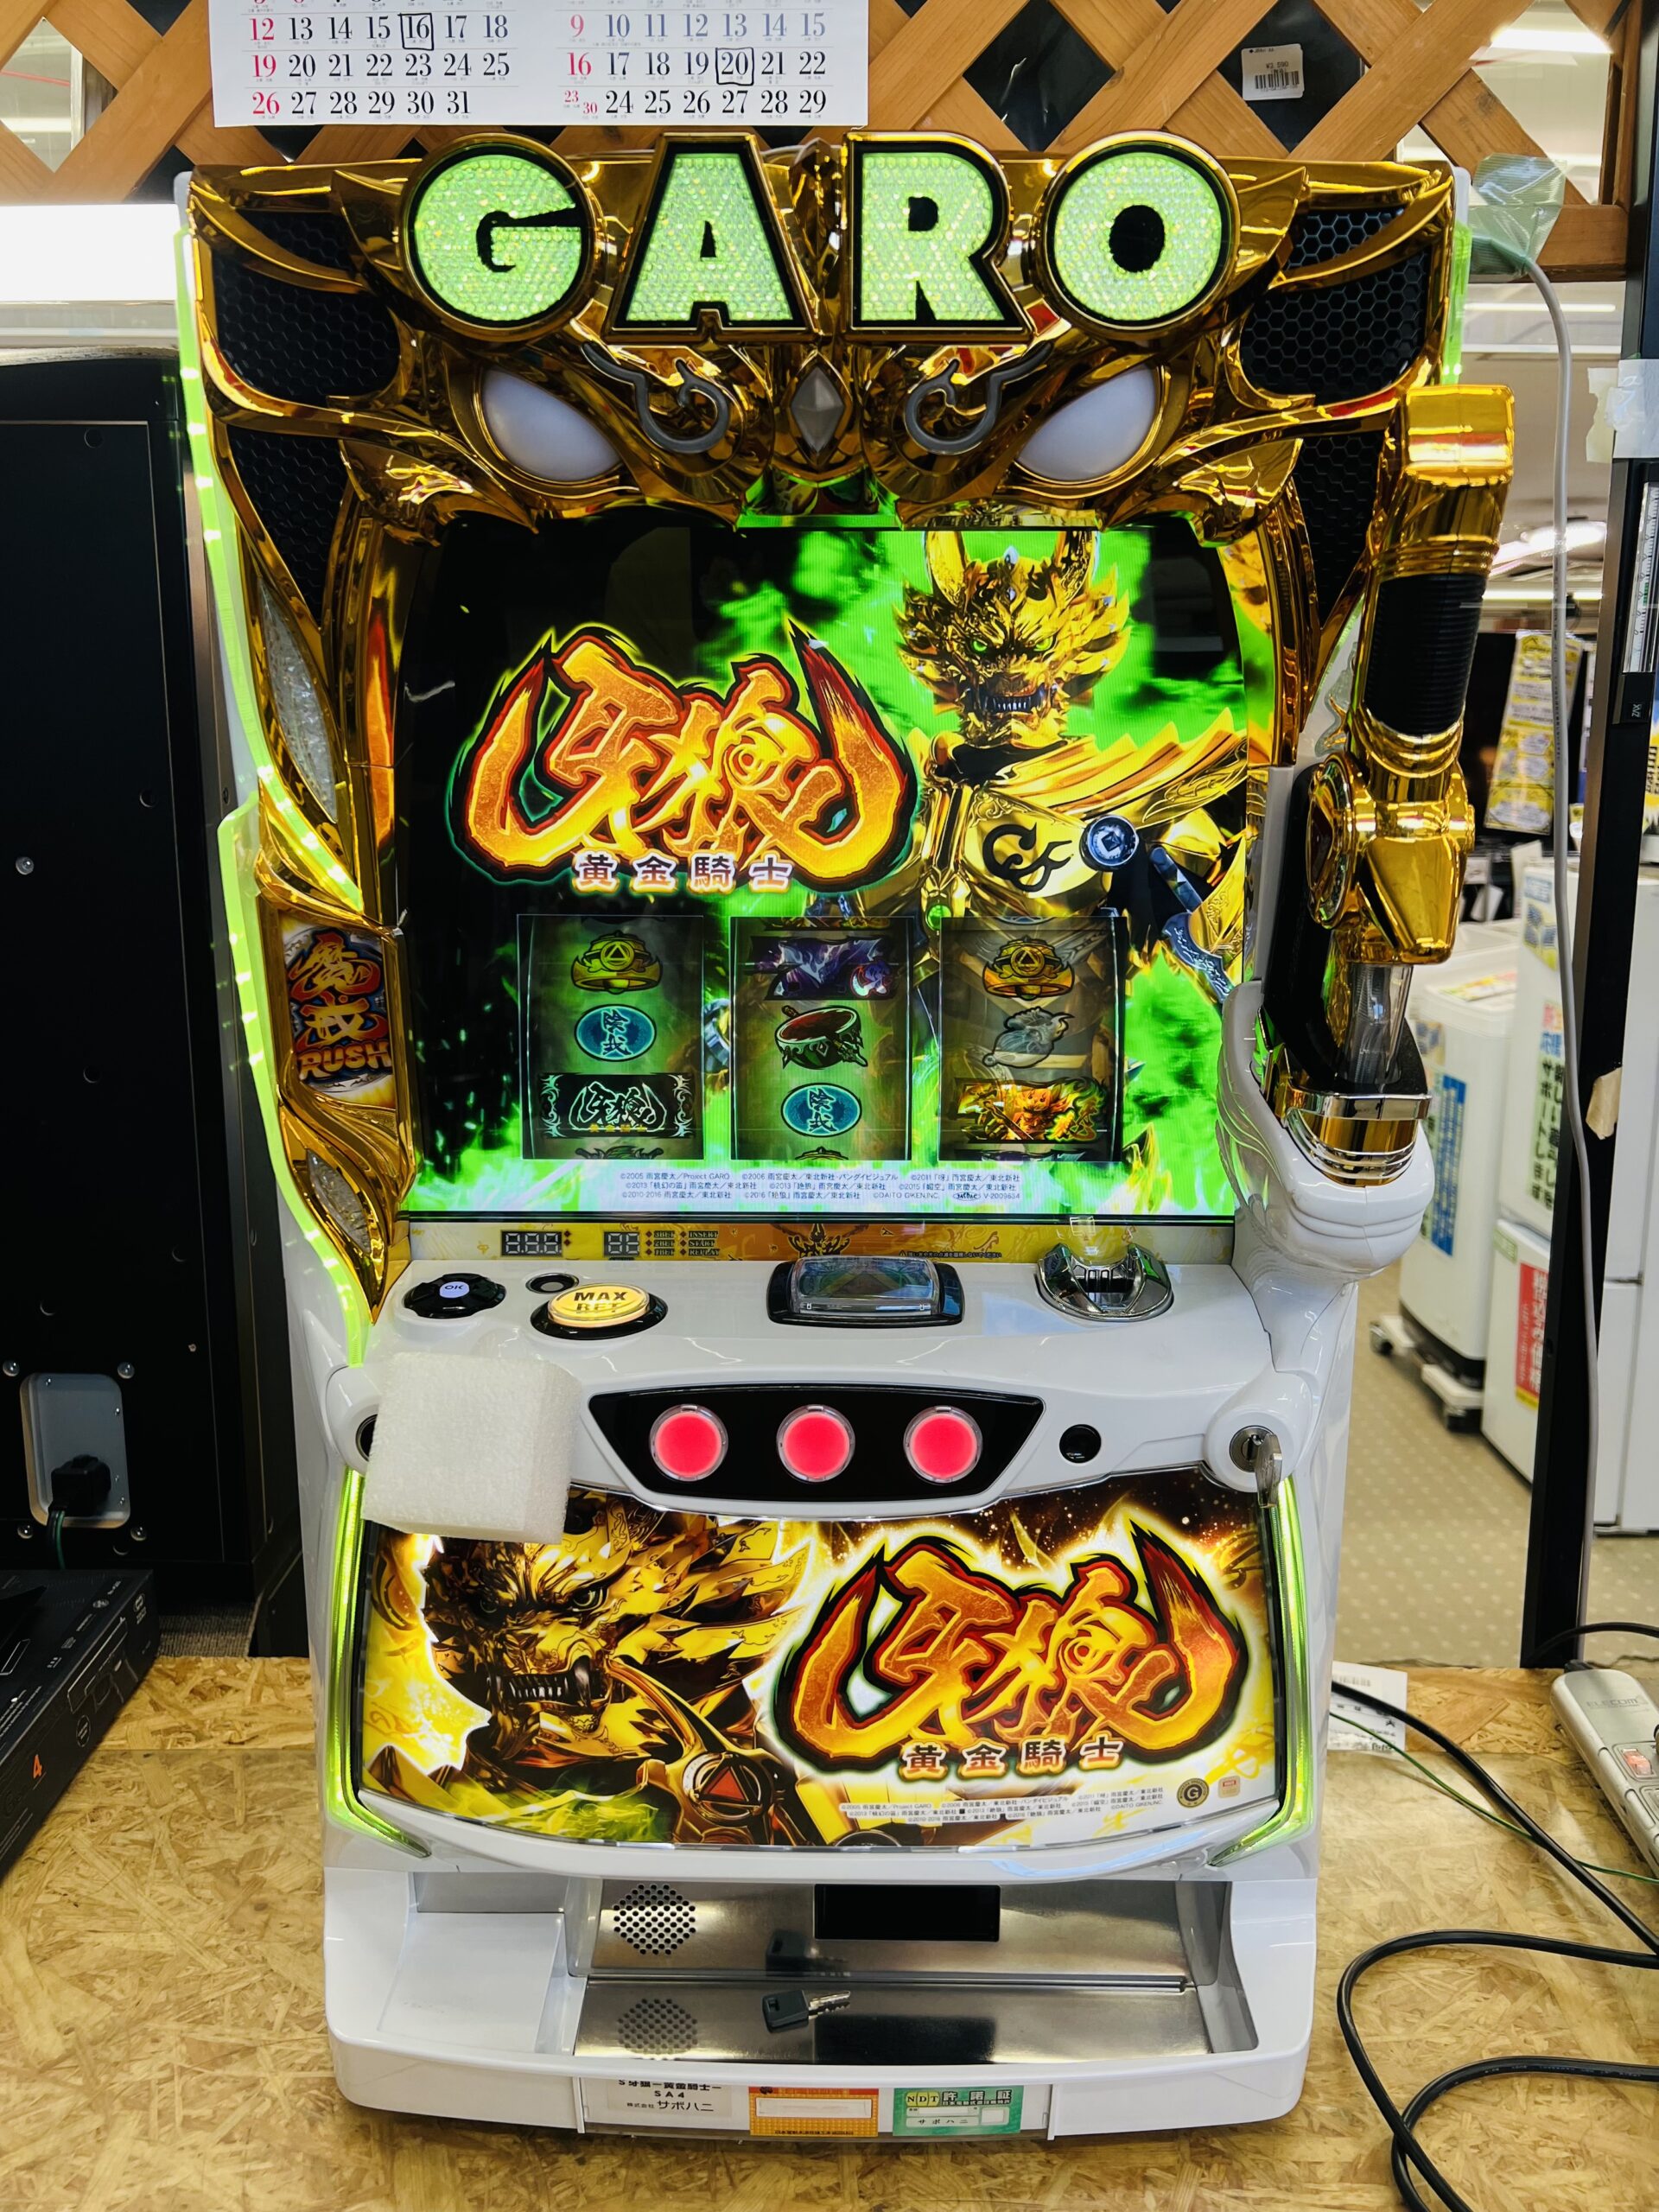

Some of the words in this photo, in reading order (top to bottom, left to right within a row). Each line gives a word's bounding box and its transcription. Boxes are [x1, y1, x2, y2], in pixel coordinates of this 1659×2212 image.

[250, 18, 275, 41] 12
[289, 16, 313, 40] 13
[327, 16, 353, 40] 14
[365, 16, 391, 39] 15
[405, 16, 430, 39] 16
[443, 16, 467, 38] 17
[482, 15, 508, 38] 18
[570, 14, 584, 37] 9
[605, 14, 630, 37] 10
[645, 14, 669, 36] 11
[683, 14, 708, 37] 12
[722, 14, 747, 36] 13
[761, 13, 787, 36] 14
[800, 12, 825, 36] 15
[251, 54, 276, 77] 19
[289, 54, 315, 77] 20
[328, 54, 353, 77] 21
[365, 54, 392, 76] 22
[405, 54, 431, 76] 23
[443, 53, 472, 76] 24
[483, 52, 510, 76] 25
[567, 52, 592, 75] 16
[607, 52, 630, 75] 17
[645, 52, 670, 75] 18
[683, 52, 709, 75] 19
[721, 51, 748, 74] 20
[761, 51, 786, 75] 21
[799, 51, 826, 74] 22
[251, 92, 280, 114] 26
[291, 92, 316, 114] 27
[329, 92, 357, 114] 28
[368, 92, 395, 114] 29
[407, 91, 434, 114] 30
[447, 91, 470, 114] 31
[564, 91, 579, 103] 23
[583, 103, 598, 114] 30
[606, 90, 633, 113] 24
[645, 90, 671, 113] 25
[683, 90, 710, 113] 26
[722, 90, 748, 113] 27
[760, 90, 788, 113] 28
[799, 90, 826, 113] 29
[408, 142, 1229, 332] GARO
[572, 849, 794, 893] 黄金騎士
[299, 1039, 392, 1082] RUSH
[574, 1292, 627, 1301] MAX
[33, 1754, 42, 1779] 4
[901, 1737, 1125, 1780] 黄金騎士
[1187, 1787, 1198, 1799] G
[906, 2094, 939, 2104] NDT
